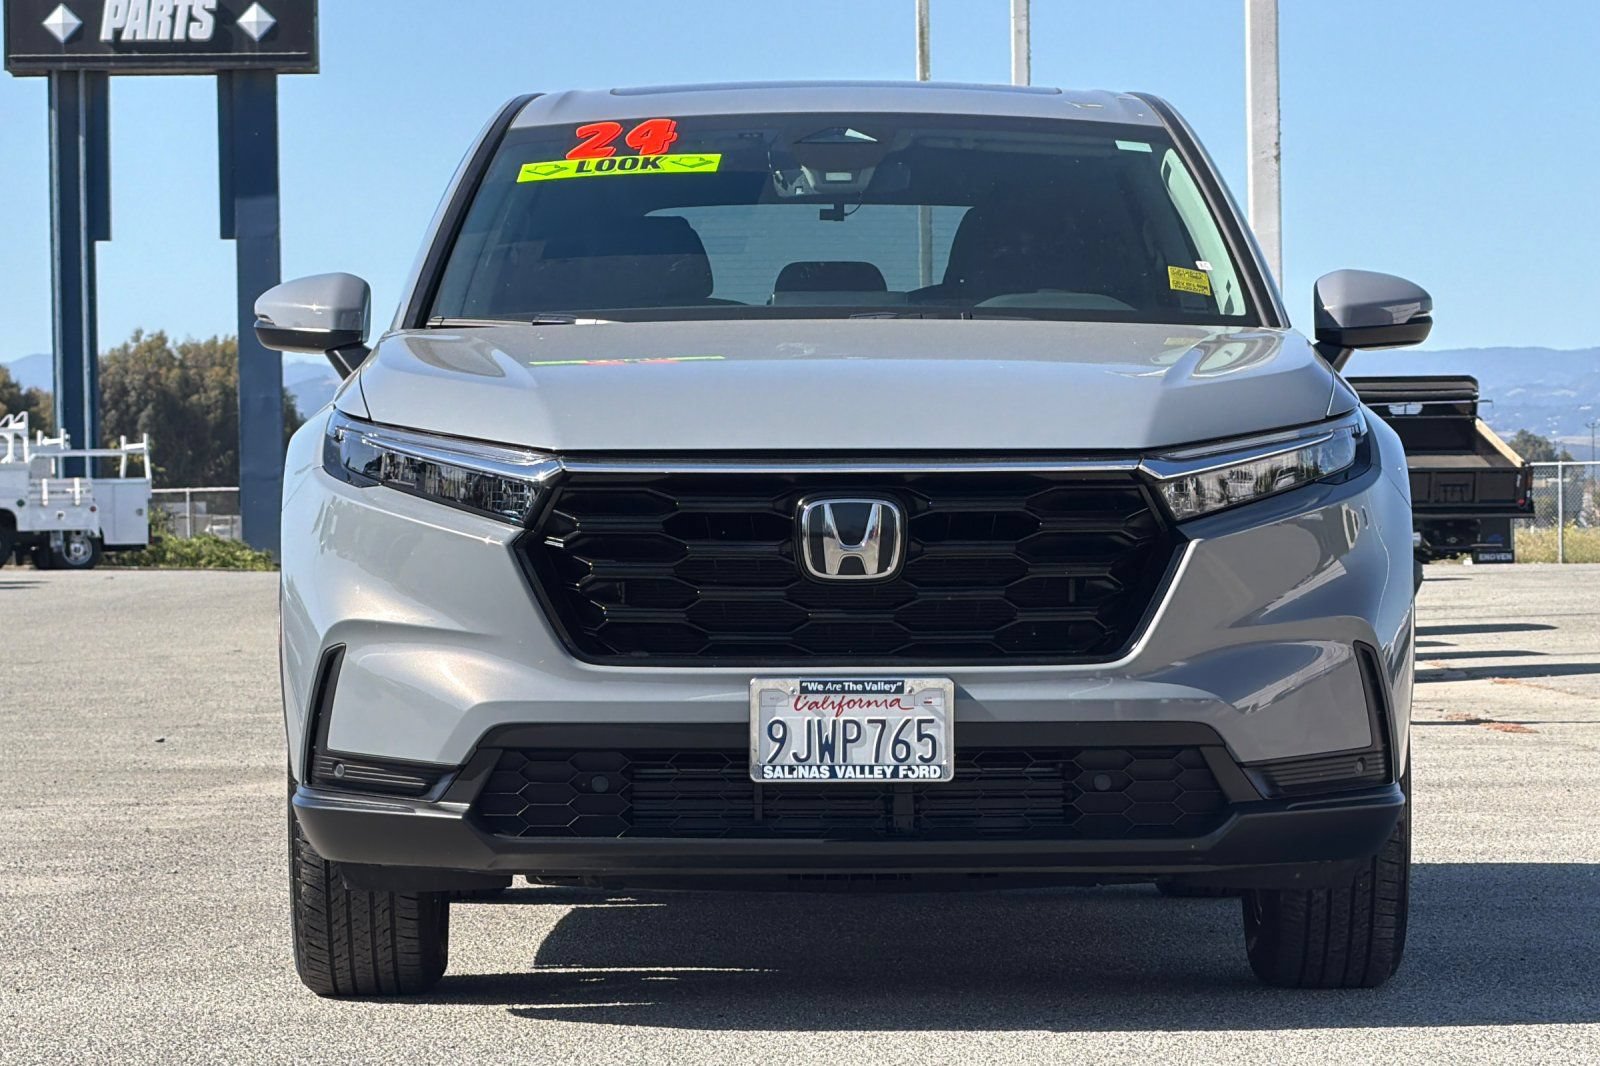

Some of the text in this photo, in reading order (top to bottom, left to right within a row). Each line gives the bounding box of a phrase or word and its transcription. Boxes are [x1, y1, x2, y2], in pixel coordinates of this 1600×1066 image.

[99, 0, 217, 41] PARTS
[566, 119, 678, 159] 24
[575, 156, 666, 173] LOOK
[826, 682, 841, 692] Are
[843, 682, 862, 692] The
[793, 695, 915, 717] California
[766, 718, 938, 764] 9JWP765
[763, 765, 941, 779] SALINAS VALLEY FORD
